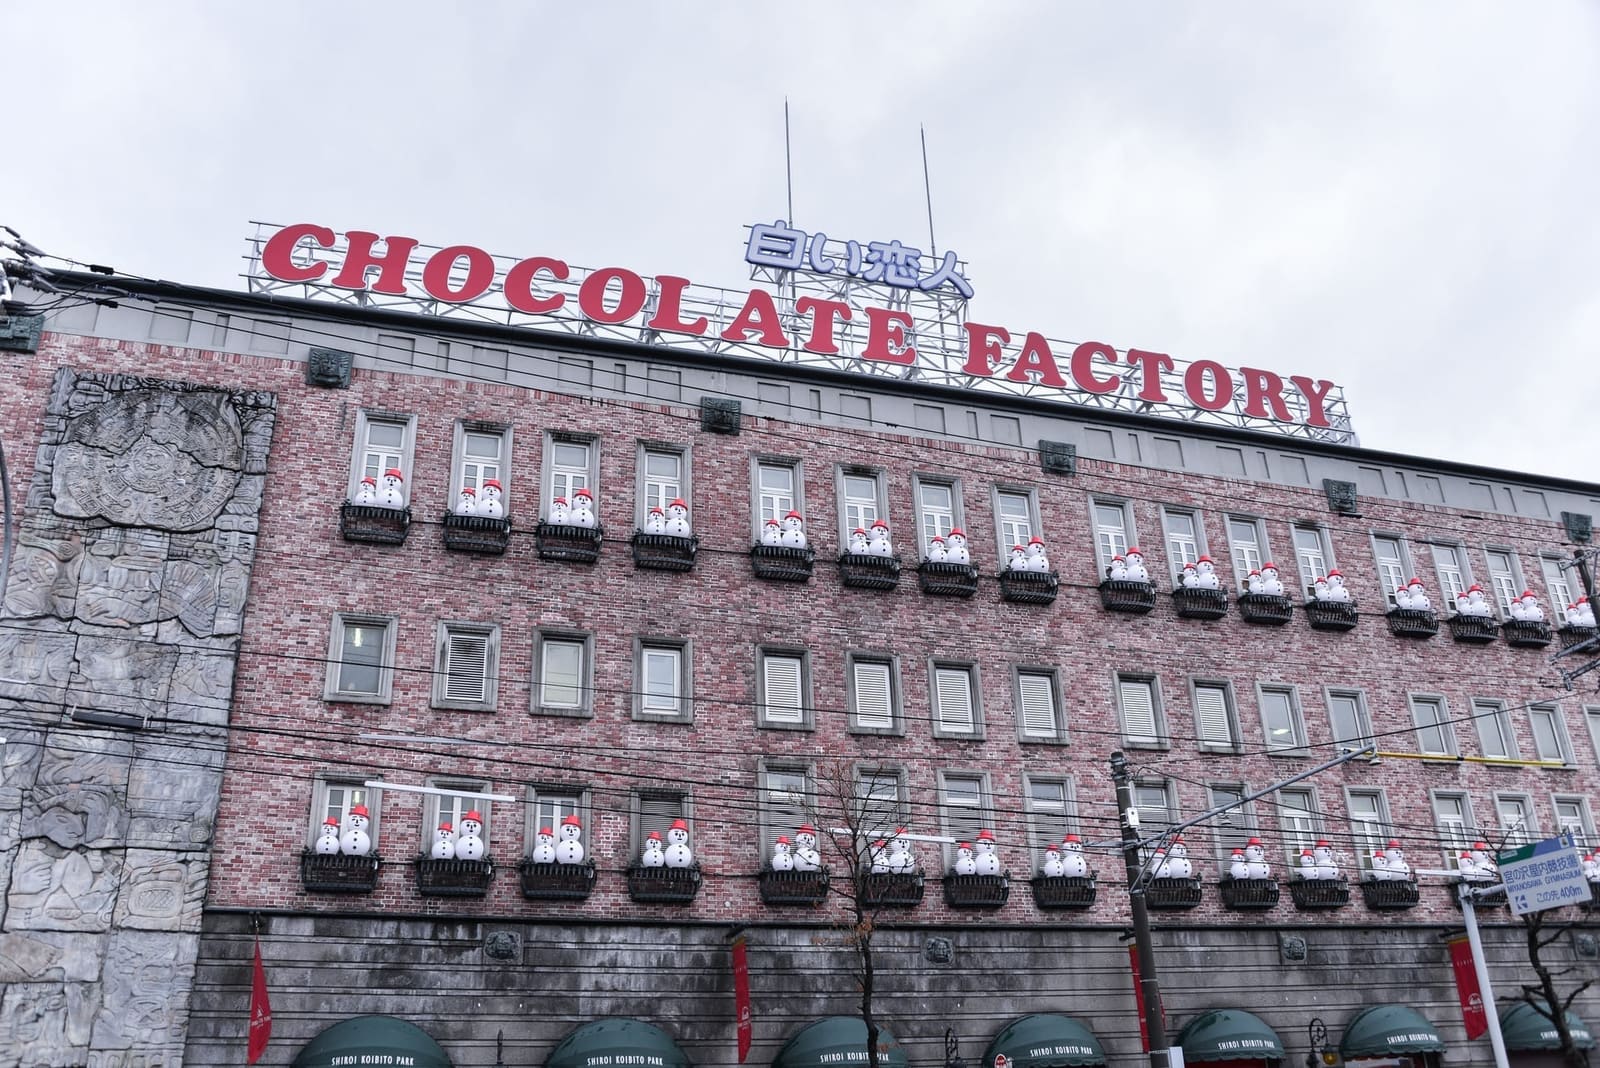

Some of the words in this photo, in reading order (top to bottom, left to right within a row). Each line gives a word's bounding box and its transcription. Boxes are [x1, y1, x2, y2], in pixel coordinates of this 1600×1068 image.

[746, 220, 974, 298] 白い恋人
[262, 223, 917, 365] CHOCOLATE
[961, 321, 1334, 428] FACTORY
[1545, 869, 1582, 884] GYMNASIUM
[1218, 1040, 1240, 1050] SHIROI
[820, 1052, 844, 1063] SHIROI
[847, 1051, 869, 1061] KOIBIT
[1030, 1046, 1053, 1057] SHIROI
[1055, 1046, 1079, 1055] KOIBITO
[1080, 1046, 1093, 1055] PARK
[331, 1055, 358, 1066] SHIROI
[361, 1054, 393, 1065] KOIBITO
[396, 1056, 414, 1066] PARK
[587, 1055, 612, 1066] SHIROI
[615, 1055, 645, 1065] KOIBITO
[647, 1056, 663, 1066] PARK
